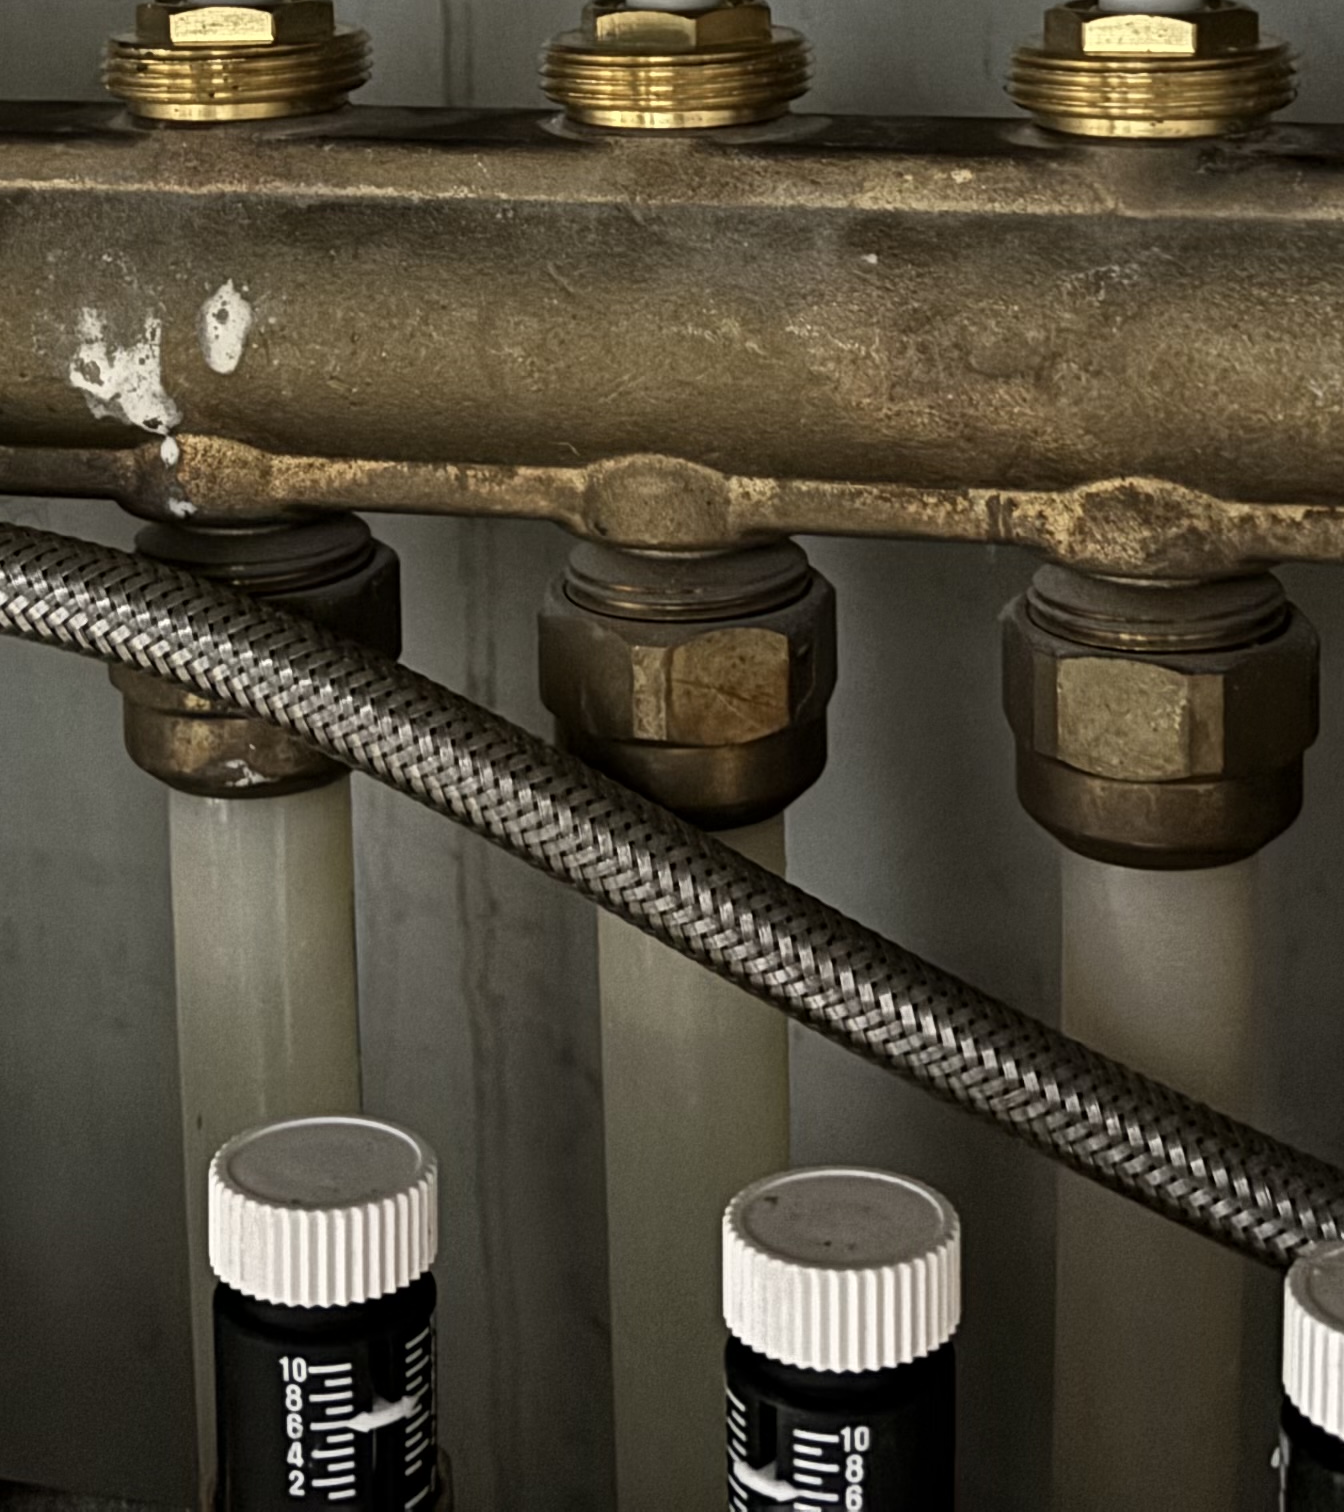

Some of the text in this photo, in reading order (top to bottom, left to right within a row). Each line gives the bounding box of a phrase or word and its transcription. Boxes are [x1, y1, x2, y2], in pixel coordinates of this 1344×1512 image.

[278, 1355, 307, 1383] 10
[285, 1384, 303, 1411] 8
[286, 1413, 303, 1439] 6
[840, 1426, 870, 1452] 10
[286, 1441, 304, 1468] 4
[845, 1454, 864, 1483] 8
[288, 1469, 306, 1497] 2
[845, 1484, 863, 1512] 6
